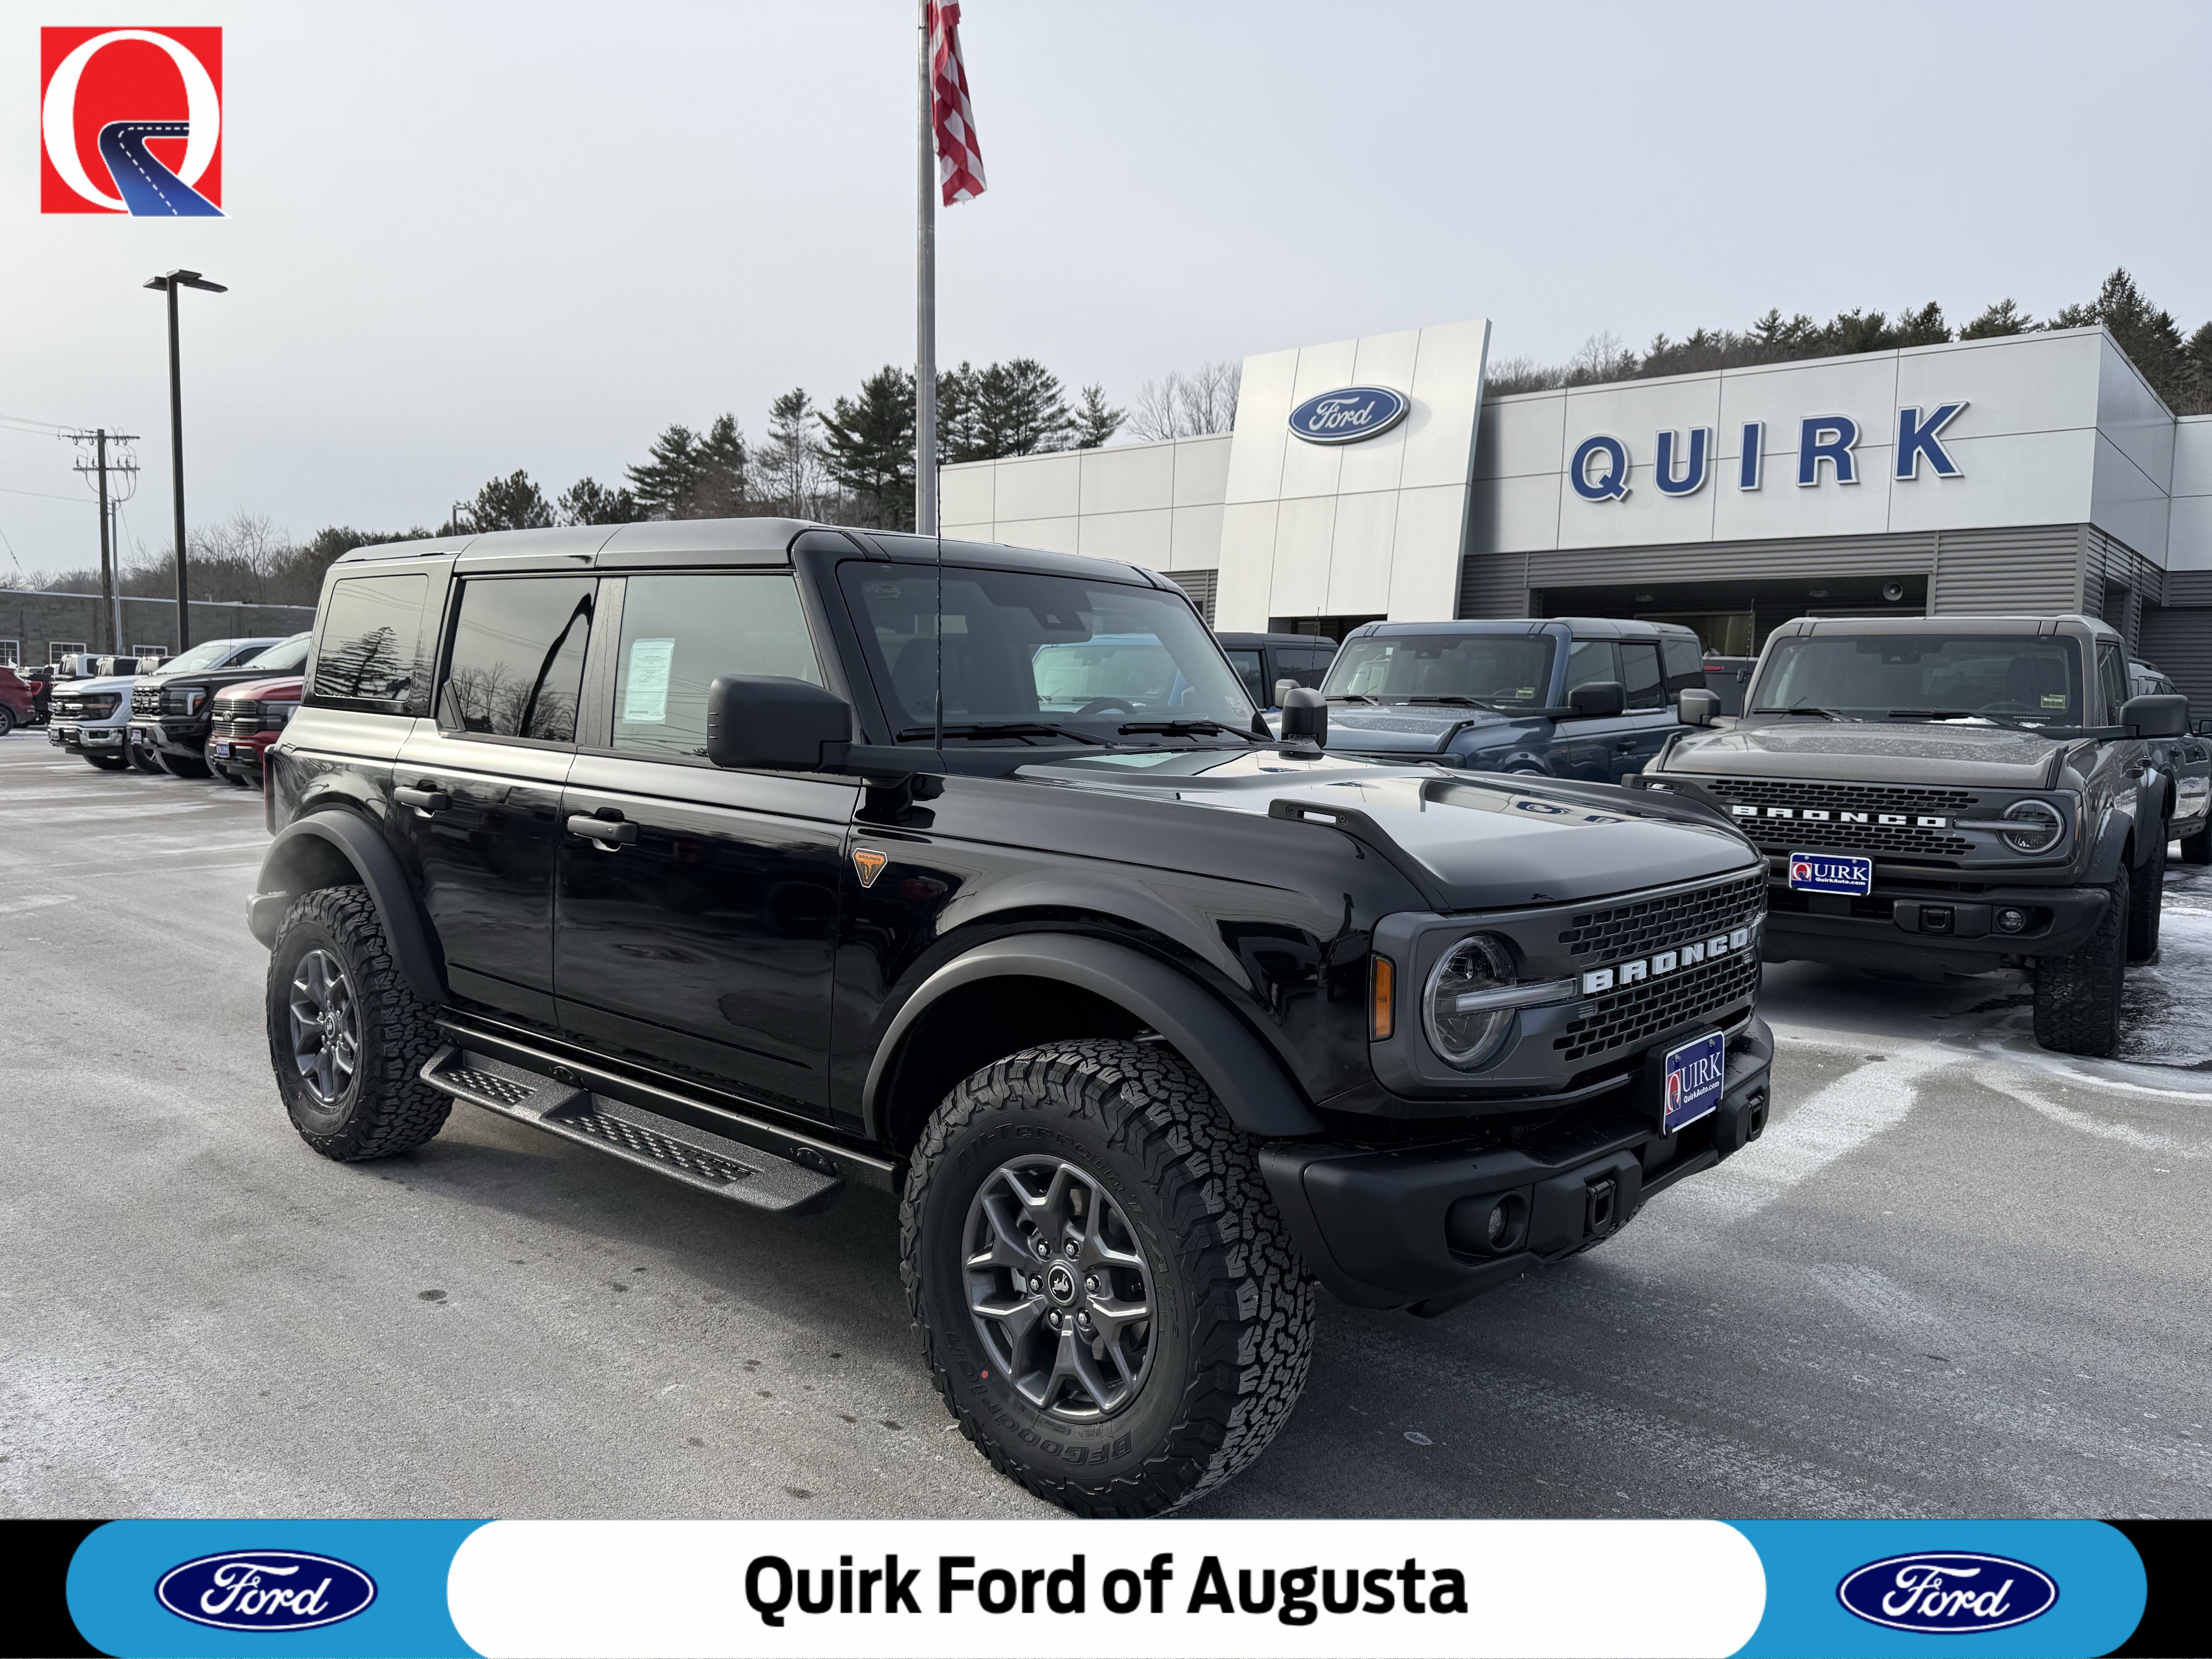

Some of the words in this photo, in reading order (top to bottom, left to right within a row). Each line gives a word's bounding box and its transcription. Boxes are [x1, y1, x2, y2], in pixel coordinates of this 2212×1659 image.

[1309, 397, 1376, 431] Ford
[1569, 401, 1968, 501] QUIRK
[1732, 805, 1946, 828] BRONCO
[1792, 862, 1869, 881] QUIRK
[1815, 877, 1866, 886] QuirkAuto.com
[1583, 928, 1748, 994] BRONCO
[1667, 1051, 1722, 1111] QUIRK
[1683, 1081, 1719, 1104] QuirkAuto.com
[957, 1123, 1125, 1190] All-Terrain
